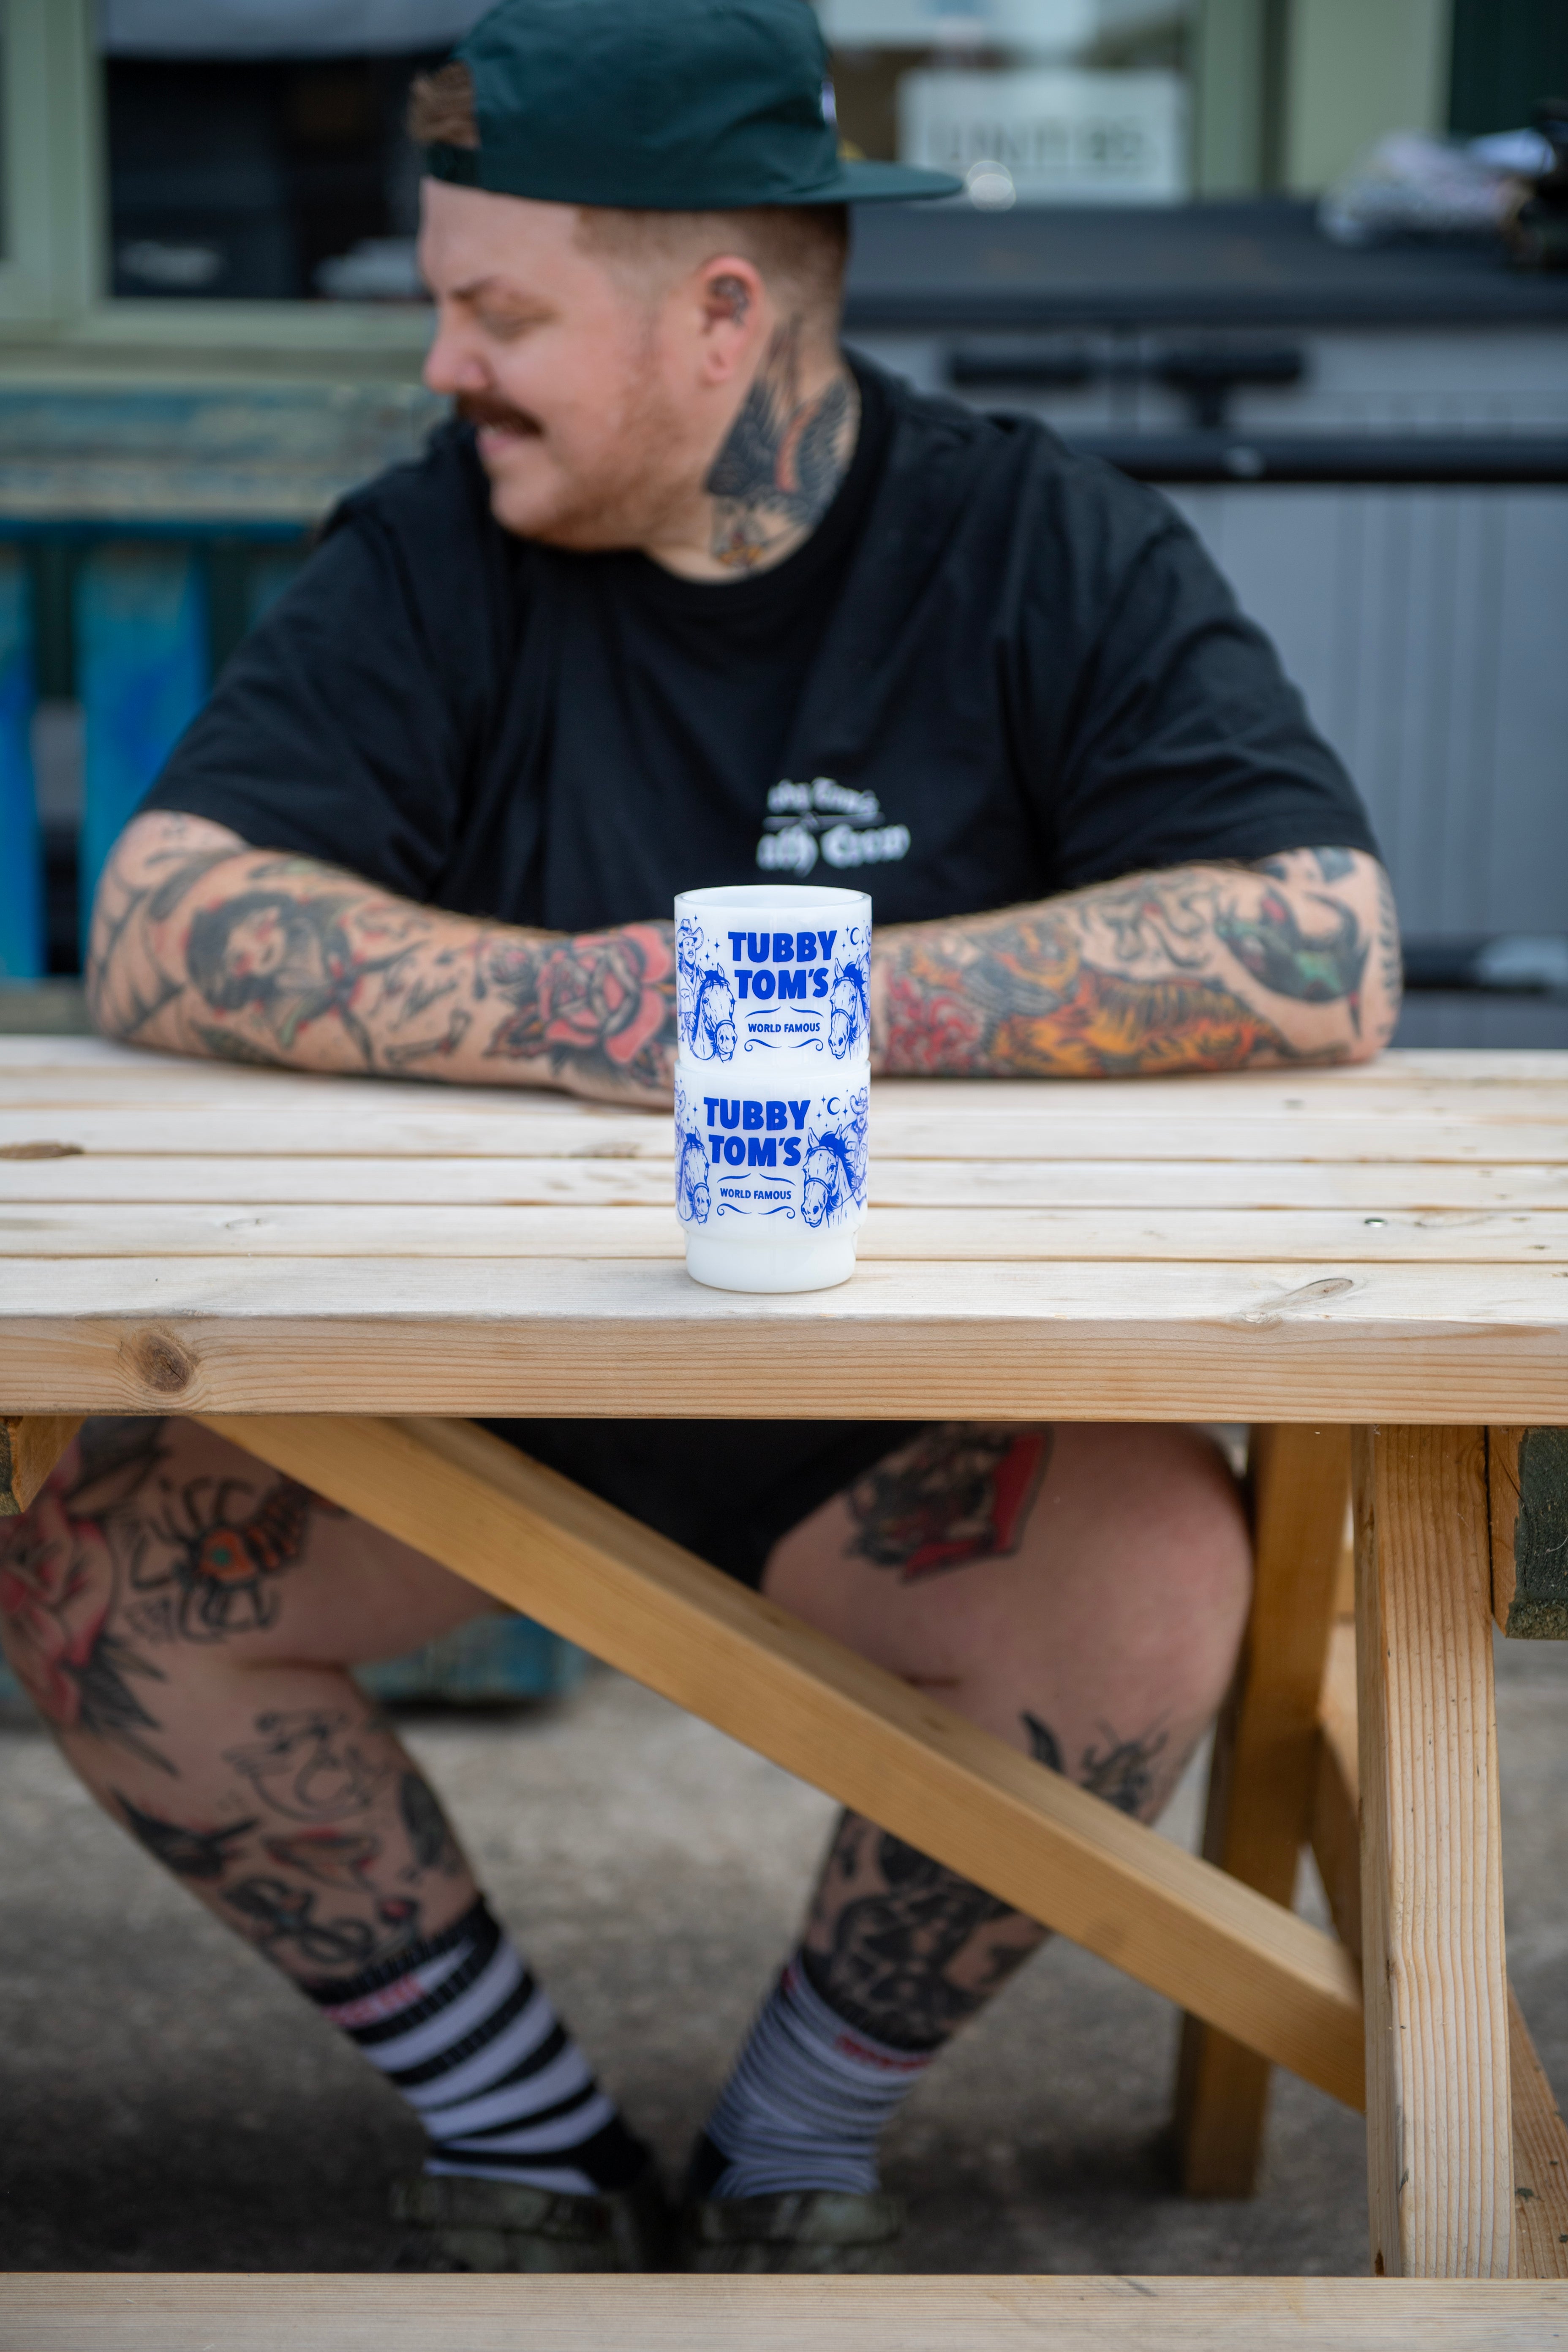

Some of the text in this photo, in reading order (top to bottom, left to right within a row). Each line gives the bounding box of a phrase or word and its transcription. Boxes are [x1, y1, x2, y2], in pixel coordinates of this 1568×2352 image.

[727, 930, 838, 963] TUBBY
[734, 967, 829, 1000] TOM'S
[748, 1023, 820, 1033] WORLD FAMOUS
[703, 1097, 811, 1131] TUBBY
[708, 1134, 802, 1167] TOM'S
[720, 1187, 792, 1200] WORLD FAMOUS
